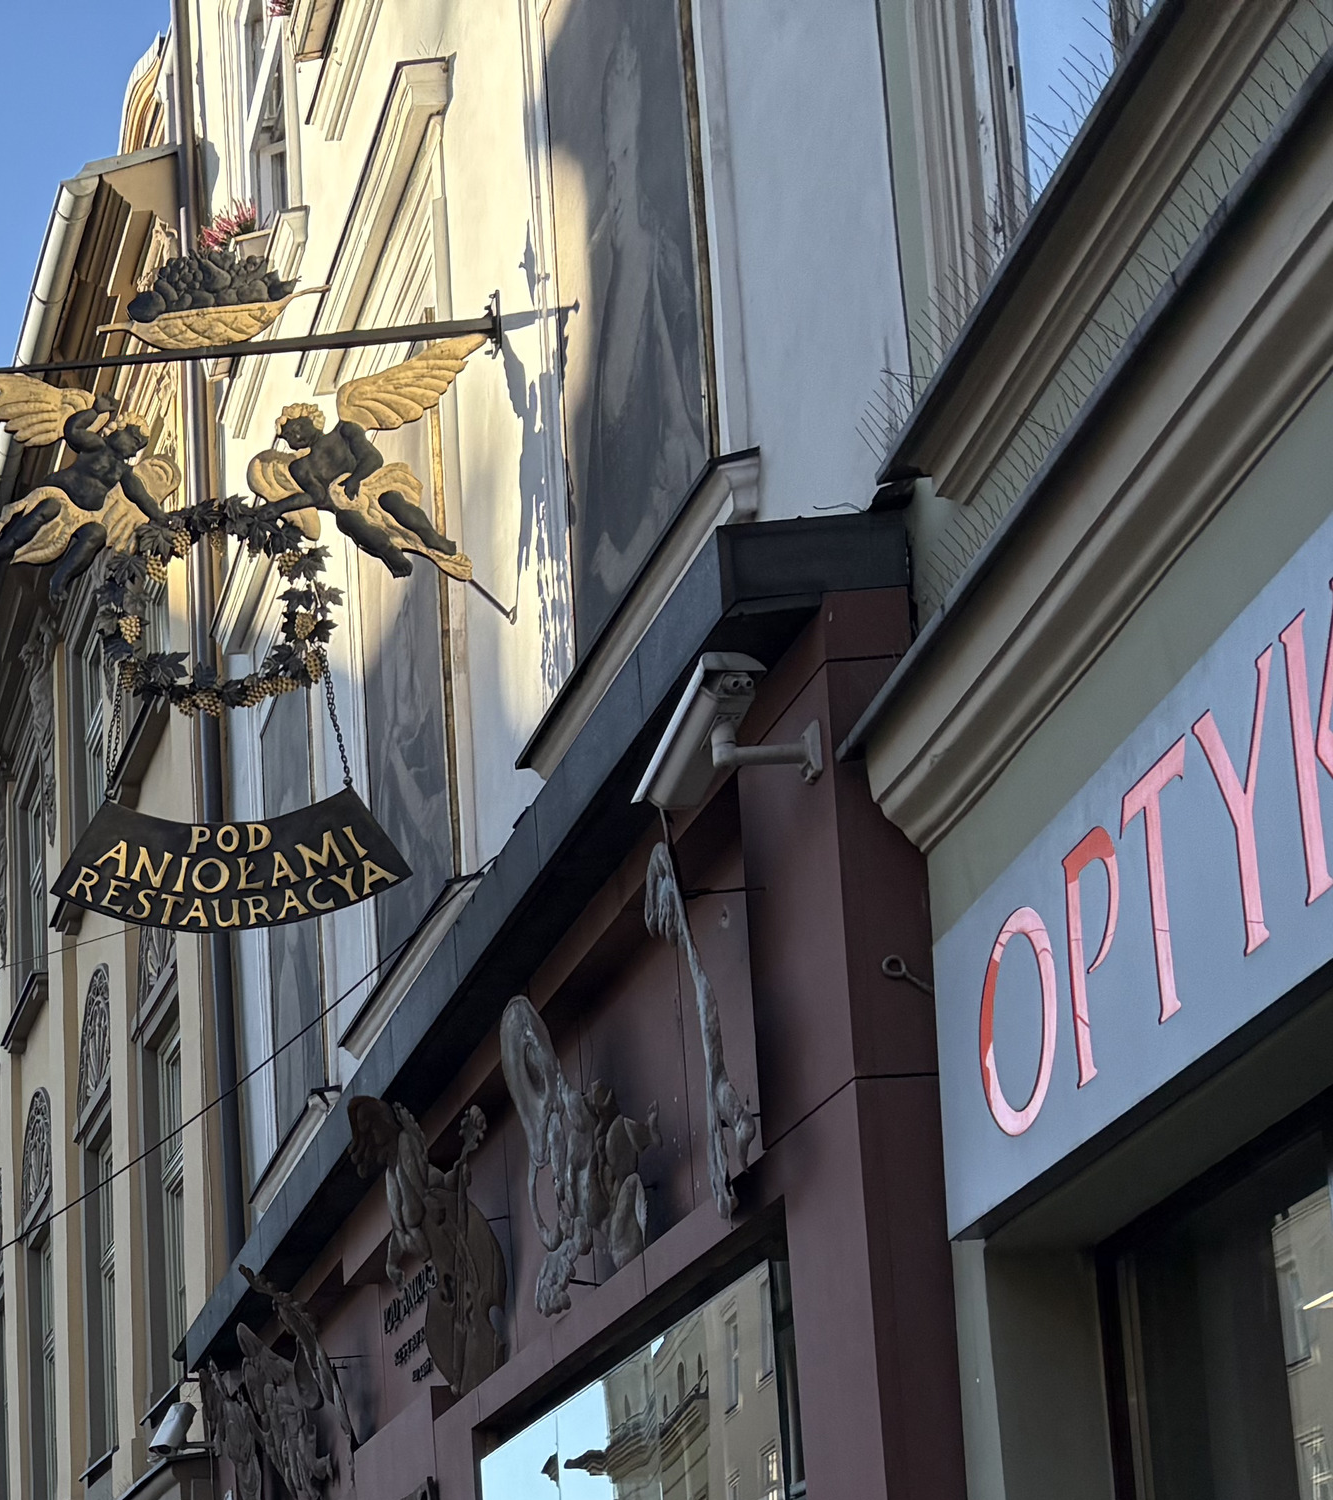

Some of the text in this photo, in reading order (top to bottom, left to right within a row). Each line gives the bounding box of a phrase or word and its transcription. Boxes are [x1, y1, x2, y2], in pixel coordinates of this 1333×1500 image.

[93, 825, 369, 894] ANIOŁAMI
[187, 824, 272, 854] POD
[66, 859, 400, 928] RESTAURACYA
